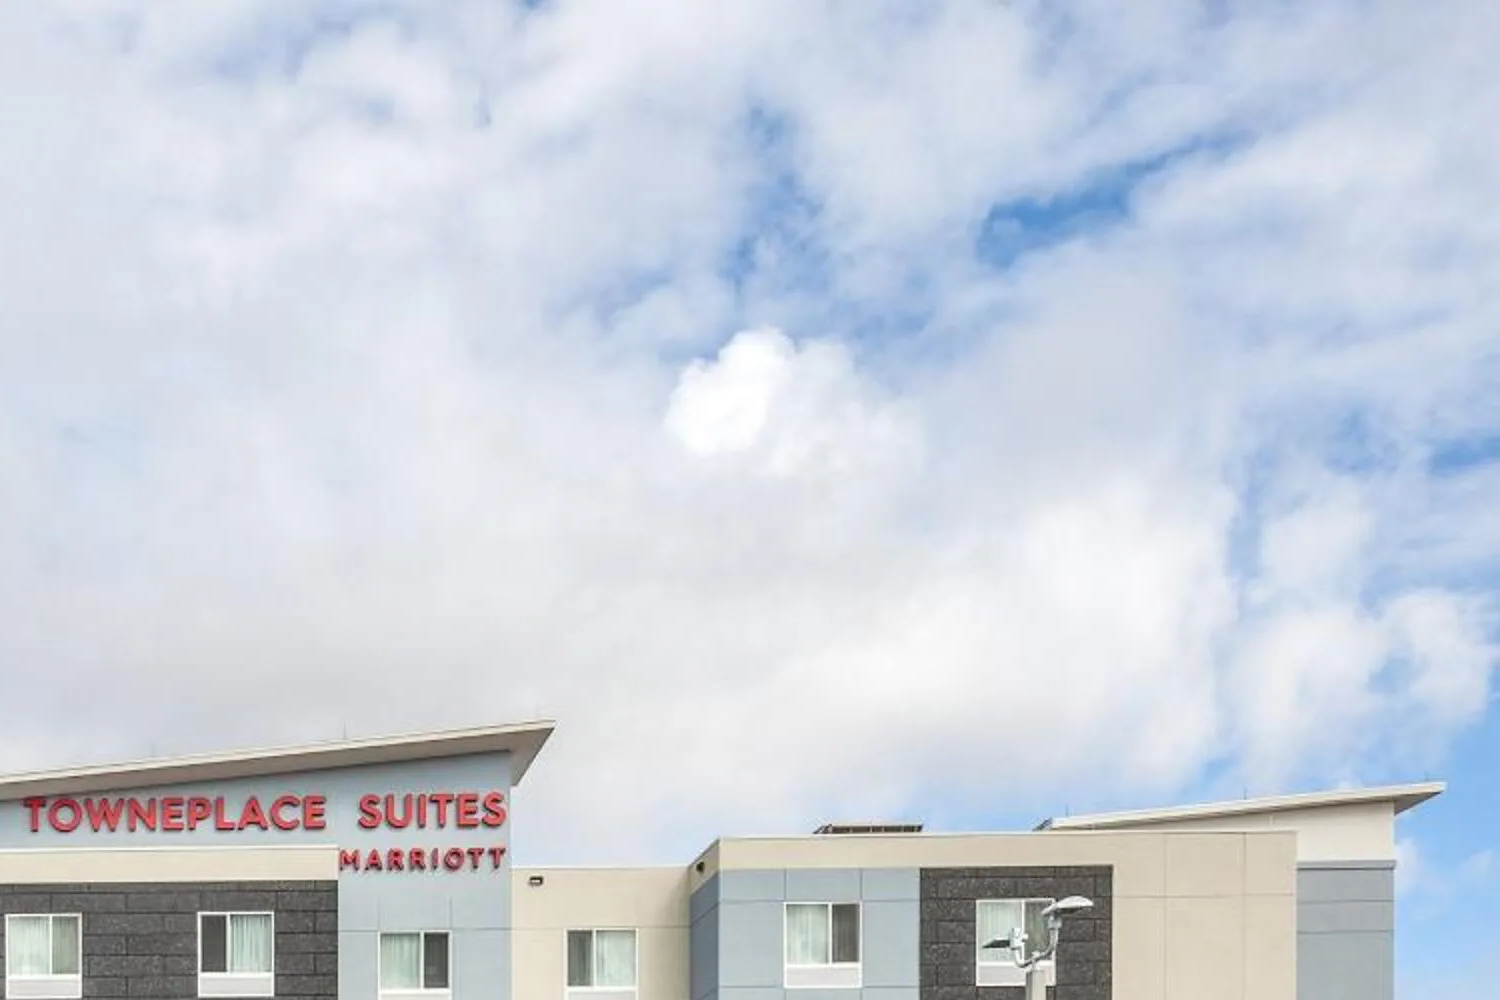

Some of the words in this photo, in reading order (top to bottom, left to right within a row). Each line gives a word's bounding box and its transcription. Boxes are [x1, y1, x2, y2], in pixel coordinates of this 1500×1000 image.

[23, 795, 327, 833] TOWNEPLACE
[357, 791, 507, 829] SUITES
[339, 847, 506, 872] MARRIOTT
